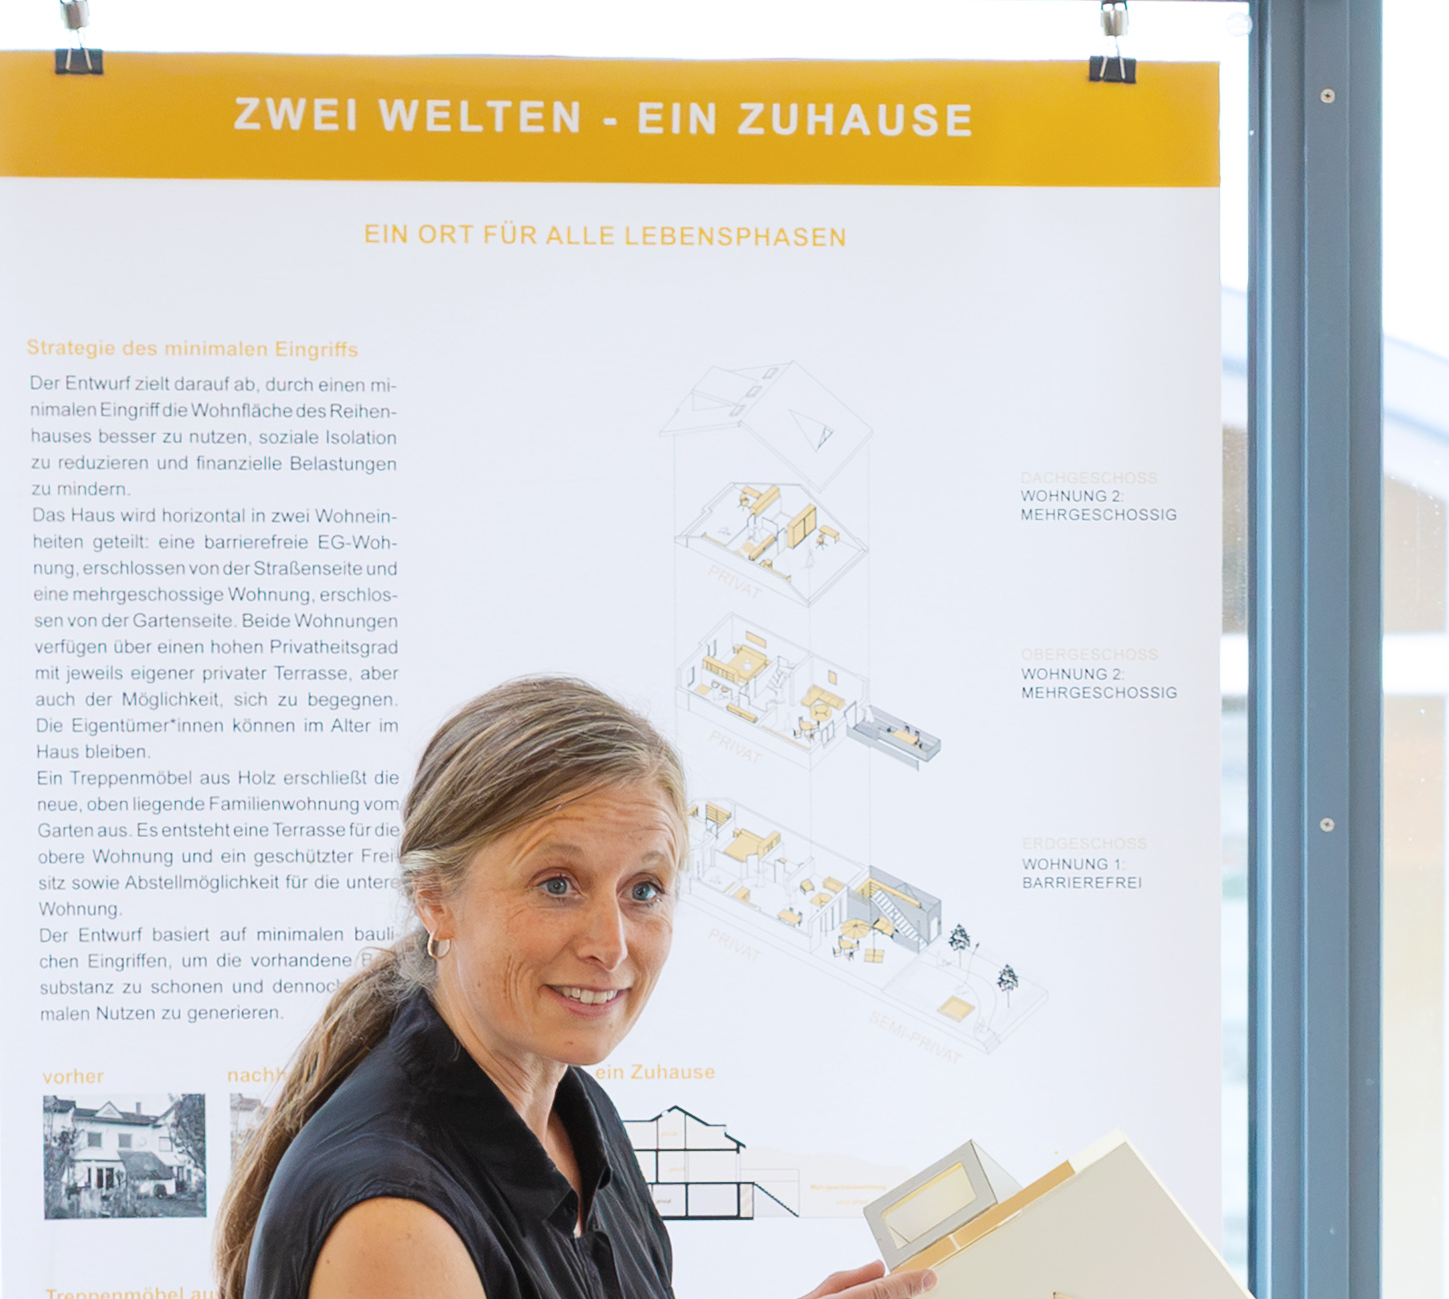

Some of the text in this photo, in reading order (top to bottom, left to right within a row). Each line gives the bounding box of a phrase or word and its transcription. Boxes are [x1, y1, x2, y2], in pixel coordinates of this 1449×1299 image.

[233, 96, 358, 132] ZWEI
[378, 96, 579, 135] WELTEN
[638, 100, 717, 136] EIN
[737, 102, 972, 139] ZUHAUSE
[364, 219, 845, 247] EIN ORT FÜR ALLE LEBENSPHASEN
[27, 338, 358, 361] Strategie des minimalen Eingriffs
[29, 374, 397, 392] Der Entwurf zielt darauf ab, durch einen mi-
[30, 401, 396, 421] nimalen Eingriff die Wohnfläche des Reihen-
[30, 427, 397, 445] hauses besser zu nutzen, soziale Isolation
[30, 454, 396, 475] zu reduzieren und finanzielle Belastungen
[1020, 488, 1125, 502] WOHNUNG 2:
[1020, 507, 1177, 521] MEHRGESCHOSSIG
[1020, 667, 1125, 680] WOHNUNG 2:
[1021, 685, 1177, 699] MEHRGESCHOSSIG
[1021, 857, 1126, 870] WOHNUNG 1:
[1022, 875, 1142, 889] BARRIEREFREI
[42, 1068, 103, 1084] vorher
[595, 1063, 715, 1080] ein Zuhause
